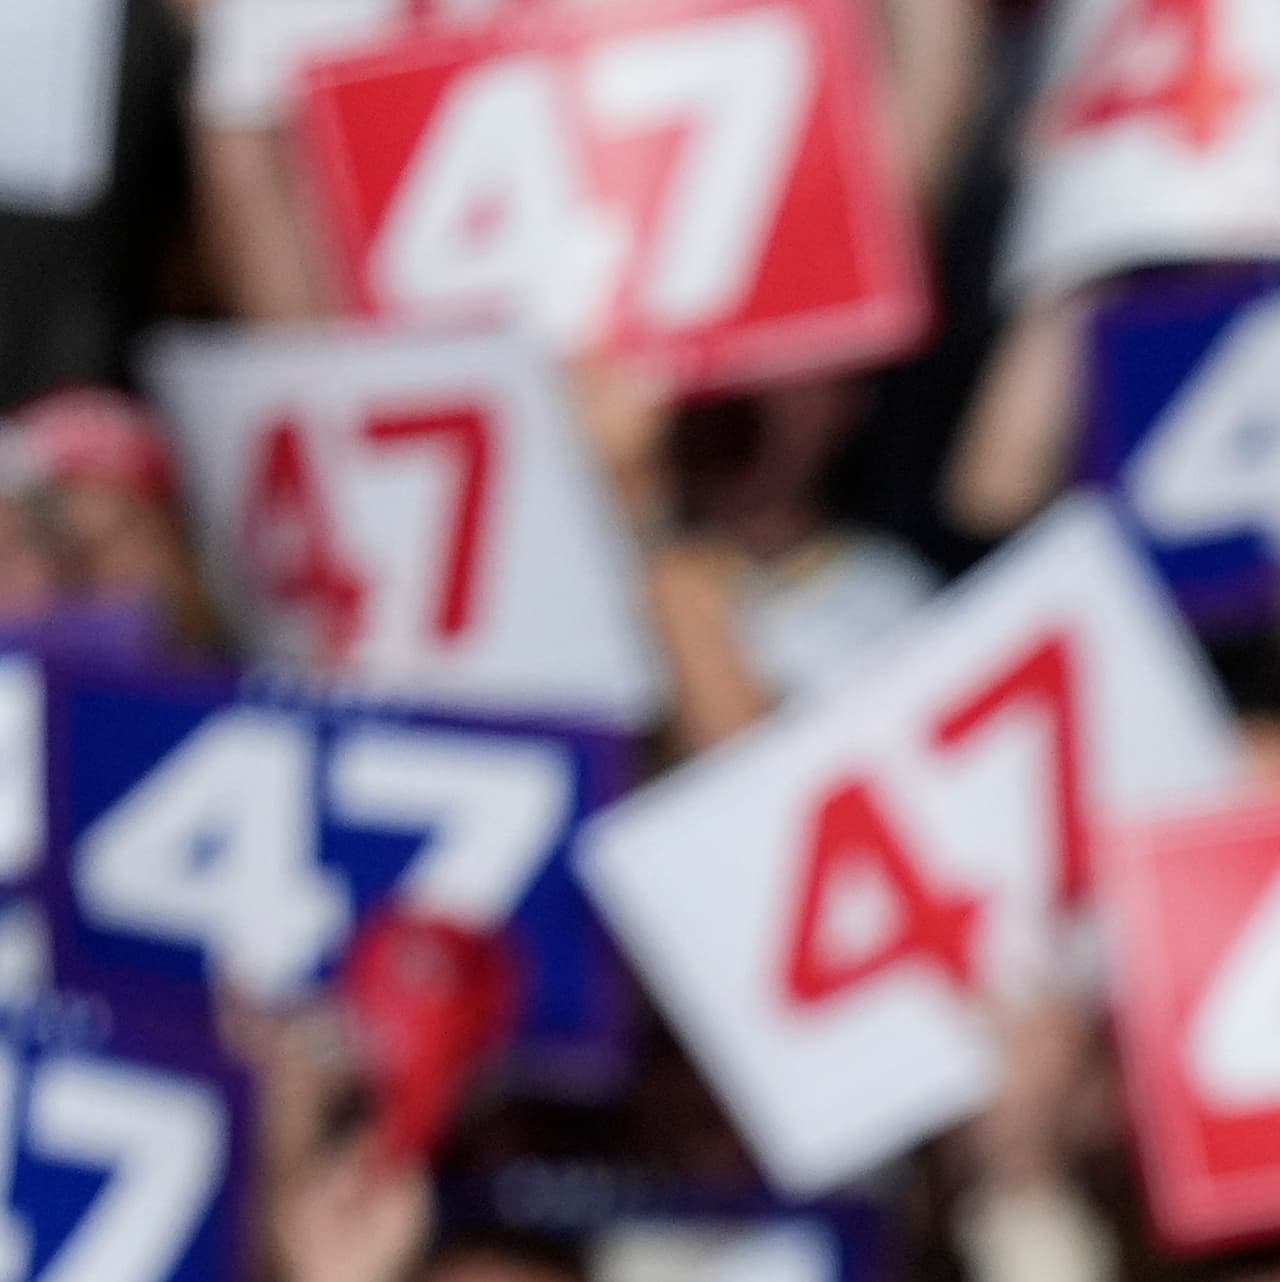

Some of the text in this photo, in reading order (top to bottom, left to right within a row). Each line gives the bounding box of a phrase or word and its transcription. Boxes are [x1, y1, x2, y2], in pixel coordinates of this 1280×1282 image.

[368, 12, 812, 350] 47
[240, 400, 492, 665] 47
[75, 695, 580, 995] 47
[775, 620, 1095, 1015] 47
